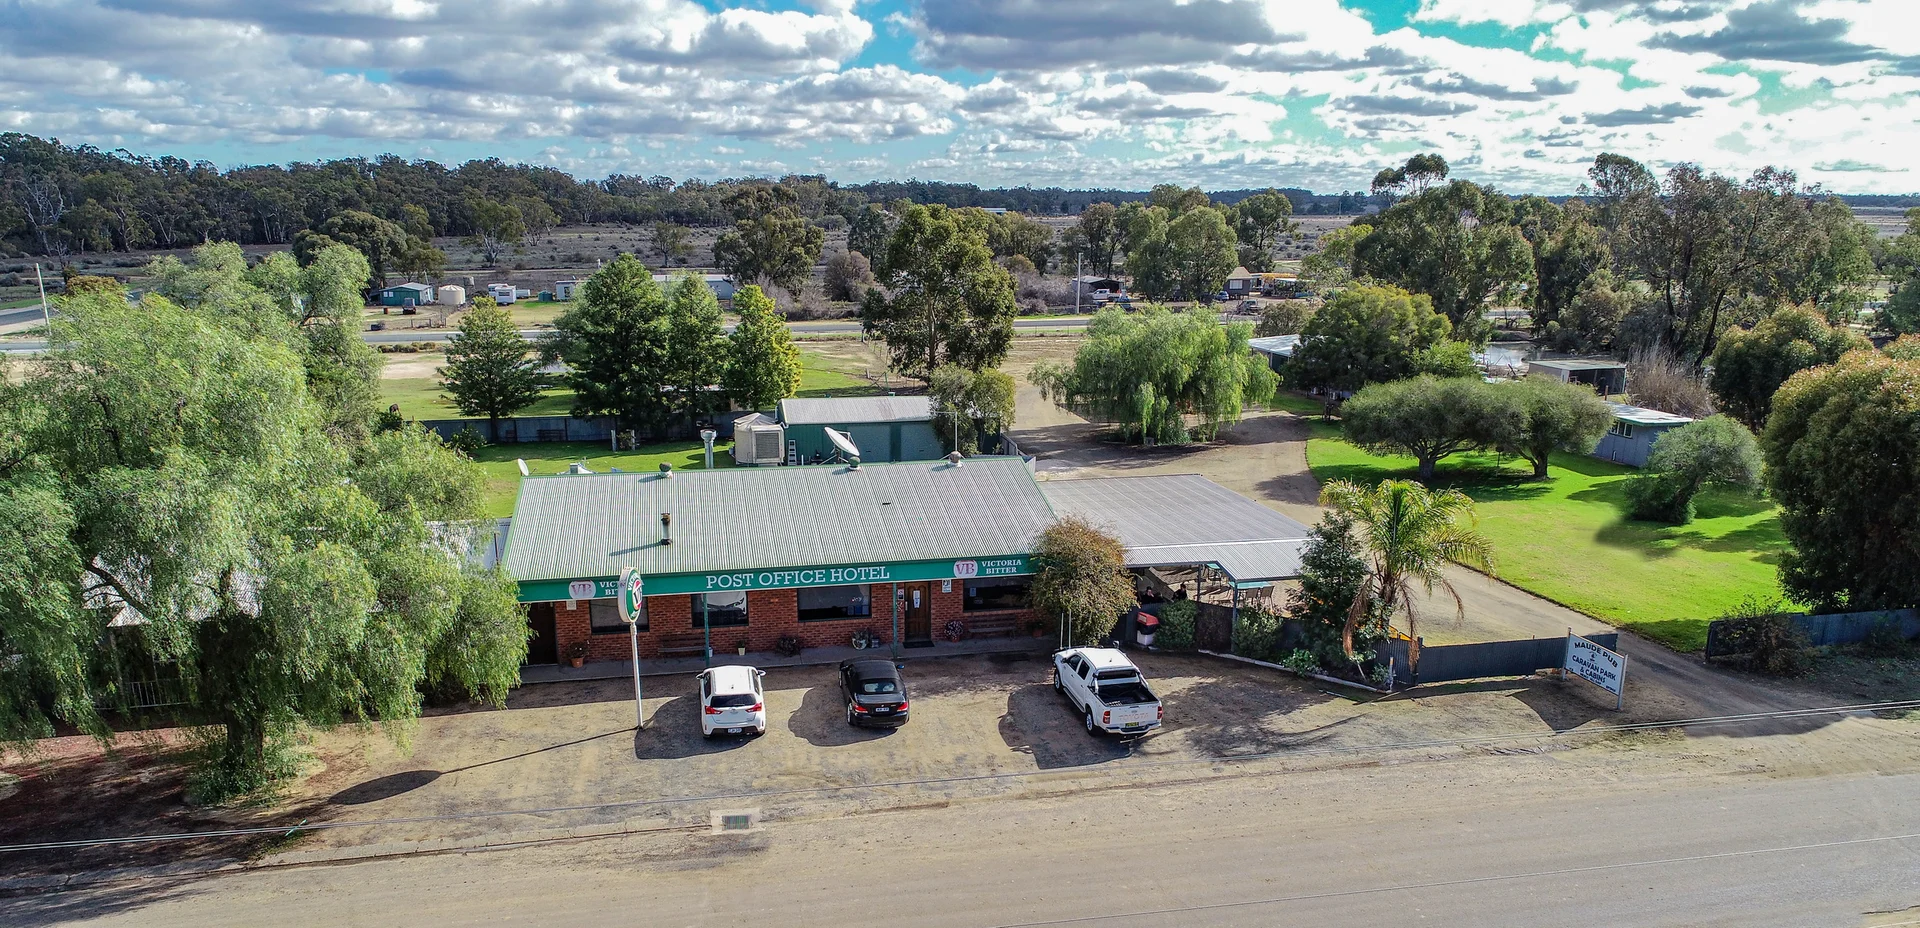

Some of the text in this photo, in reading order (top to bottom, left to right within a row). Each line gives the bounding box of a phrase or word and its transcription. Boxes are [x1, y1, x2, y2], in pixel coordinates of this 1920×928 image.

[706, 566, 890, 588] POST OFFICE HOTEL
[956, 563, 974, 574] VB
[571, 584, 592, 596] VB
[1574, 642, 1618, 668] MAUDE PUB
[1572, 655, 1600, 672] CARAVAN
[1600, 668, 1616, 680] PARK
[1586, 670, 1606, 683] CABINS
